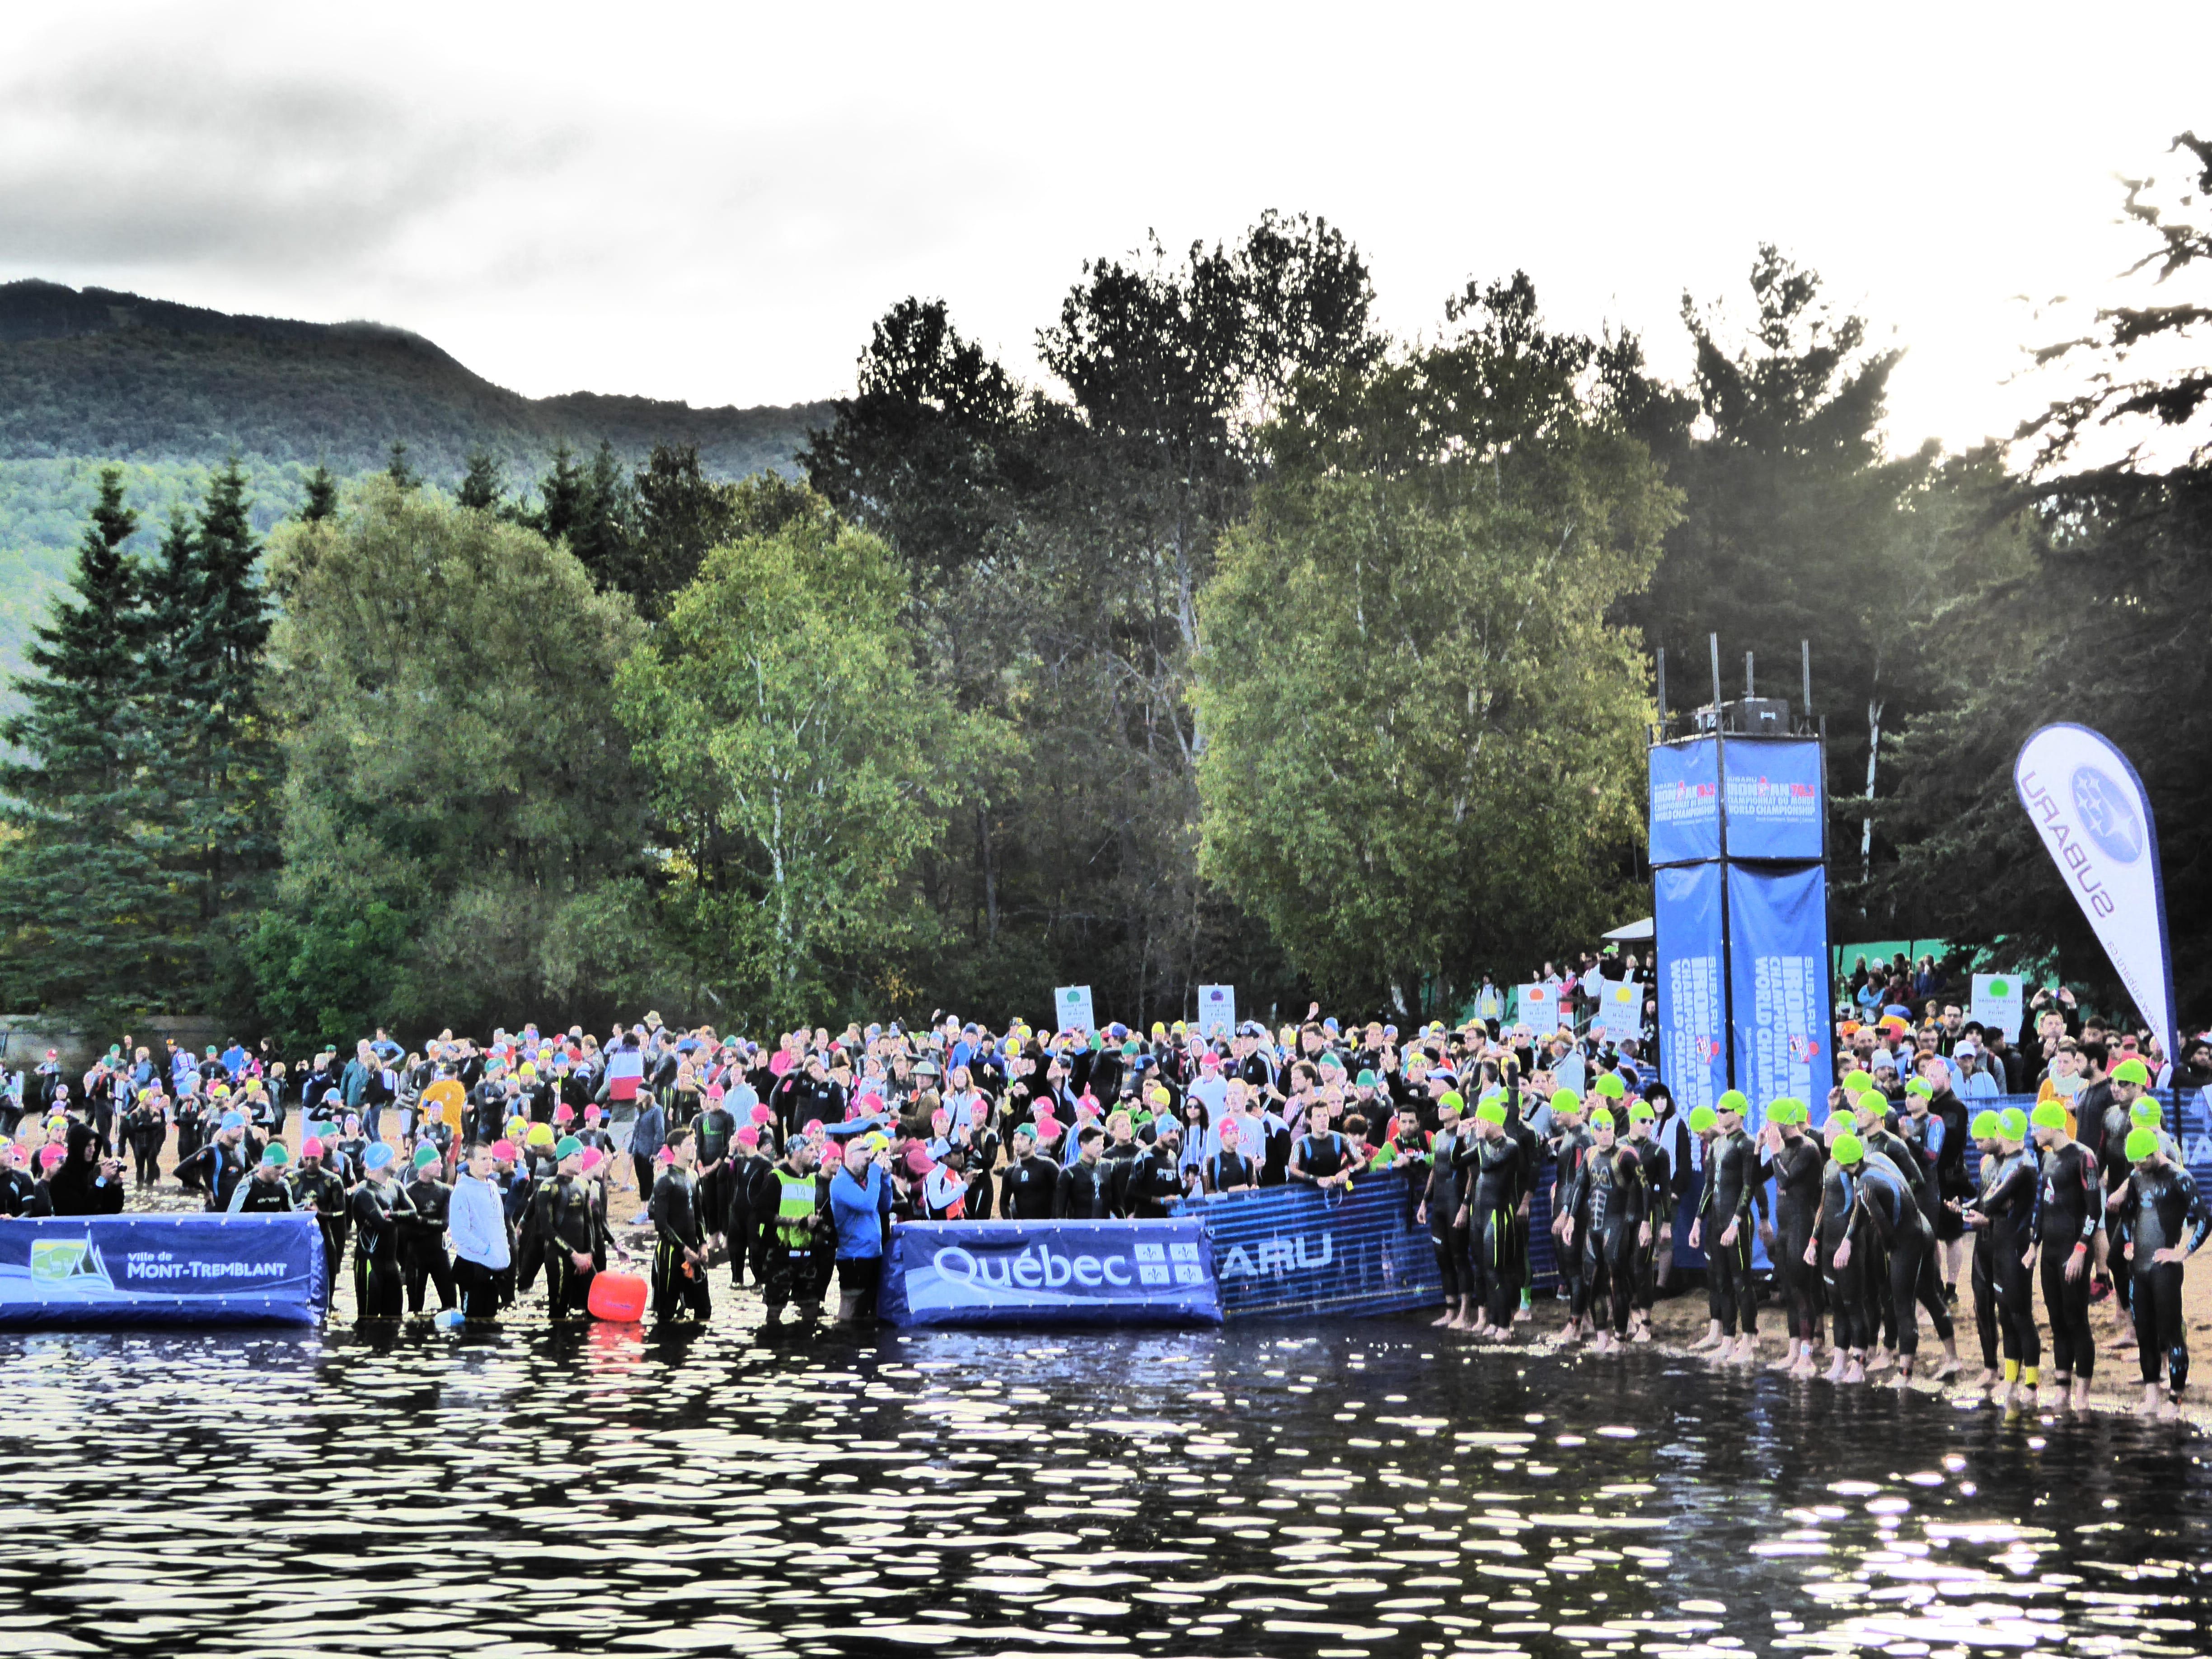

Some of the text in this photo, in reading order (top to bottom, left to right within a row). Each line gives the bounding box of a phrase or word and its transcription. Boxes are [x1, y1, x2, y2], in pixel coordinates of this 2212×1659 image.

[1670, 958, 1685, 1030] WORLD
[1681, 957, 1697, 1079] CHAMPIONNAT
[1708, 956, 1718, 1035] SUBARU
[1755, 956, 1772, 1026] WORLD
[1769, 956, 1788, 1077] CHAMPIONNAT
[1804, 956, 1816, 1035] SUBARU
[127, 1251, 172, 1262] Ville de
[127, 1261, 288, 1279] MONT-TREMBLANT
[933, 1243, 1132, 1289] Québec
[1219, 1233, 1332, 1279] ARU
